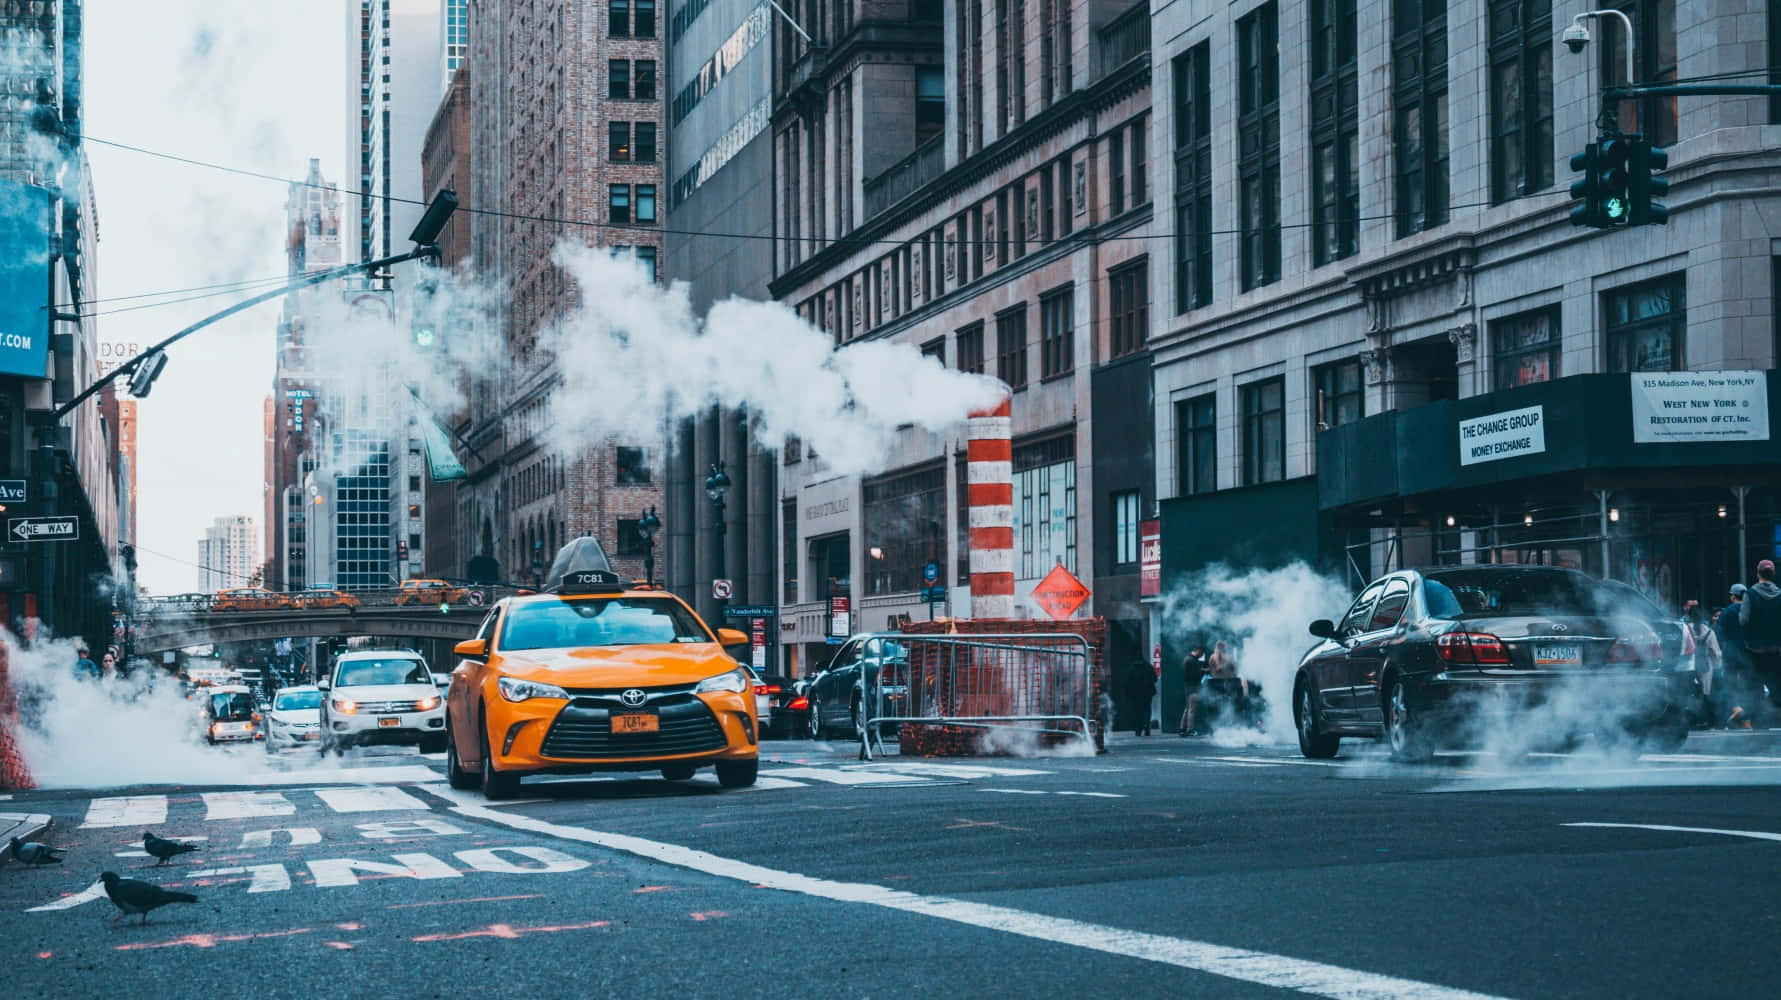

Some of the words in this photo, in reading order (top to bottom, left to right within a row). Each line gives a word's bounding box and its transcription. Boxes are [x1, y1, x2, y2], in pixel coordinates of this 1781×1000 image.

[1658, 379, 1690, 388] Madison
[1708, 379, 1725, 387] New
[1462, 424, 1476, 439] THE
[1476, 418, 1509, 437] CHANGE
[1509, 412, 1540, 430] GROUP
[1471, 444, 1493, 458] MONEY
[1494, 437, 1531, 454] EXCHANGE
[0, 485, 24, 498] Ave
[19, 524, 39, 535] ONE
[47, 523, 70, 534] WAY
[577, 574, 604, 584] 7C81
